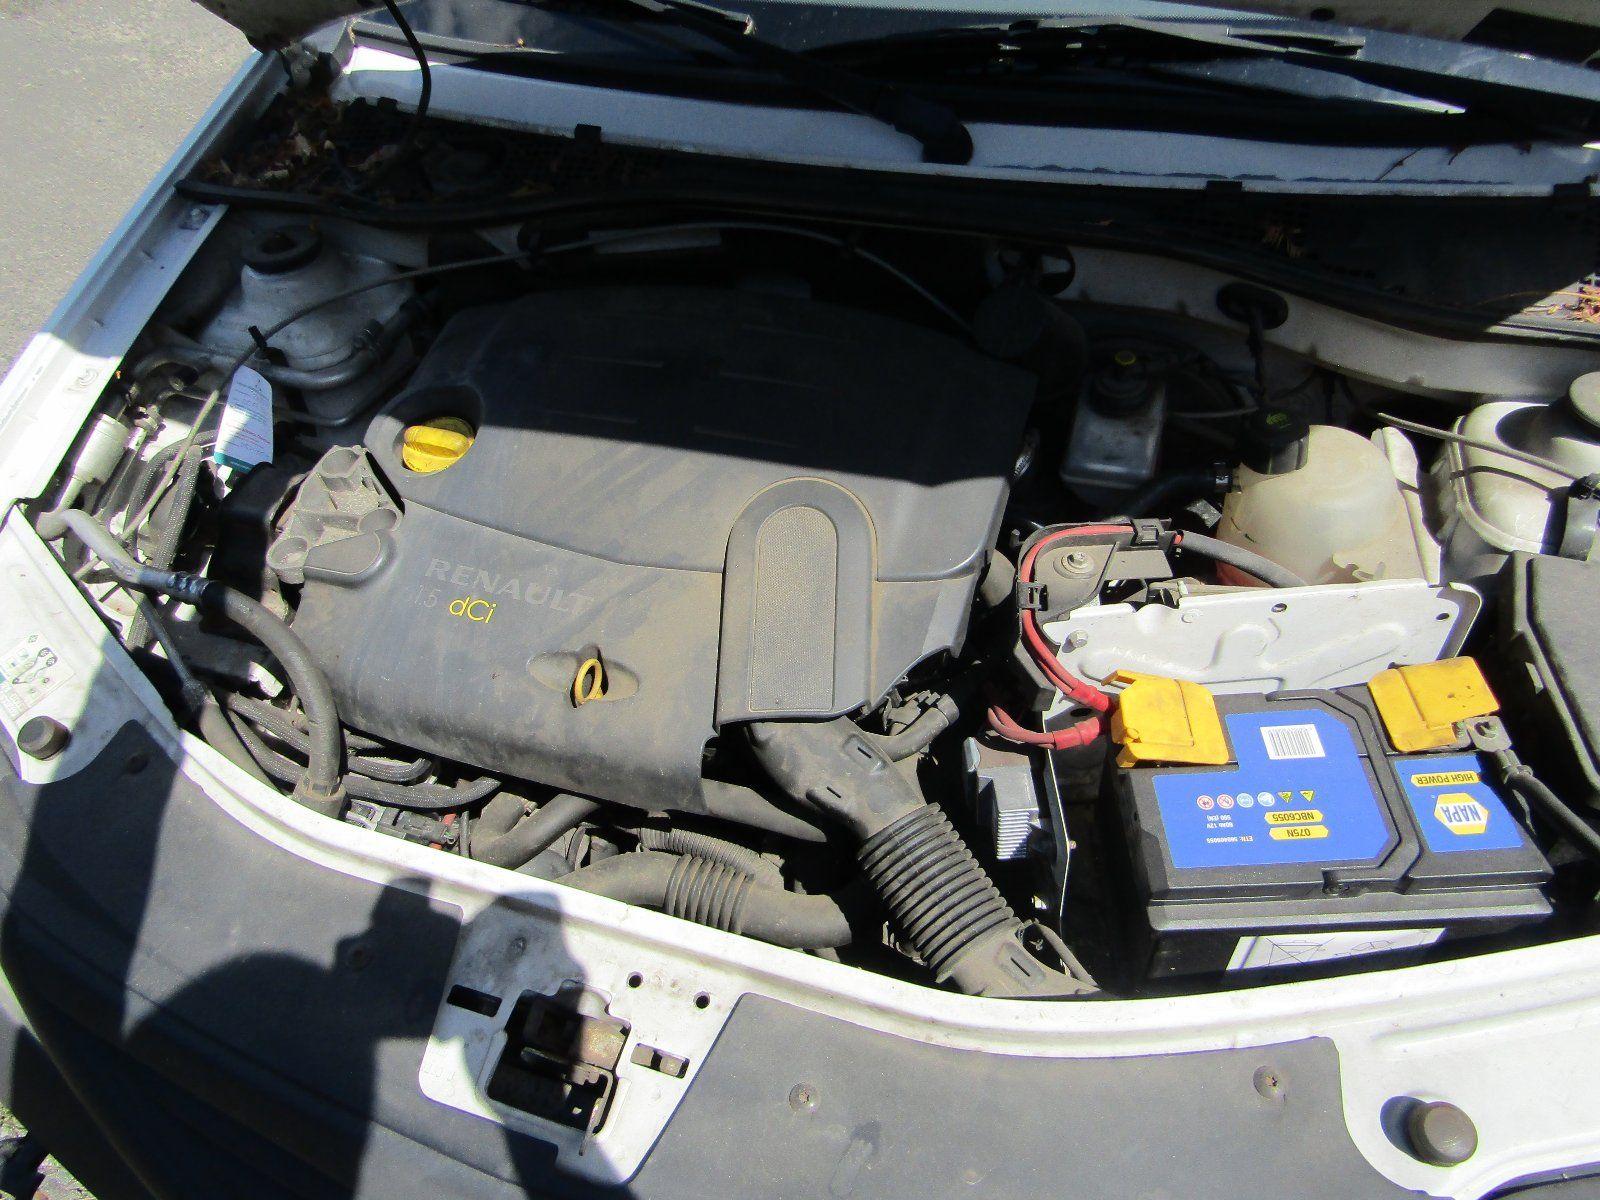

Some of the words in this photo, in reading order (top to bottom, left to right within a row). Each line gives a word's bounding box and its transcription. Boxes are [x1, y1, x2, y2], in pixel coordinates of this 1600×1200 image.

[424, 557, 595, 617] RENAULT
[449, 596, 498, 624] dCi
[1416, 775, 1450, 785] POWER
[1450, 773, 1475, 783] HIGH
[1272, 812, 1315, 822] NBC6055
[1440, 804, 1482, 824] NAPA
[1286, 828, 1311, 838] 075N
